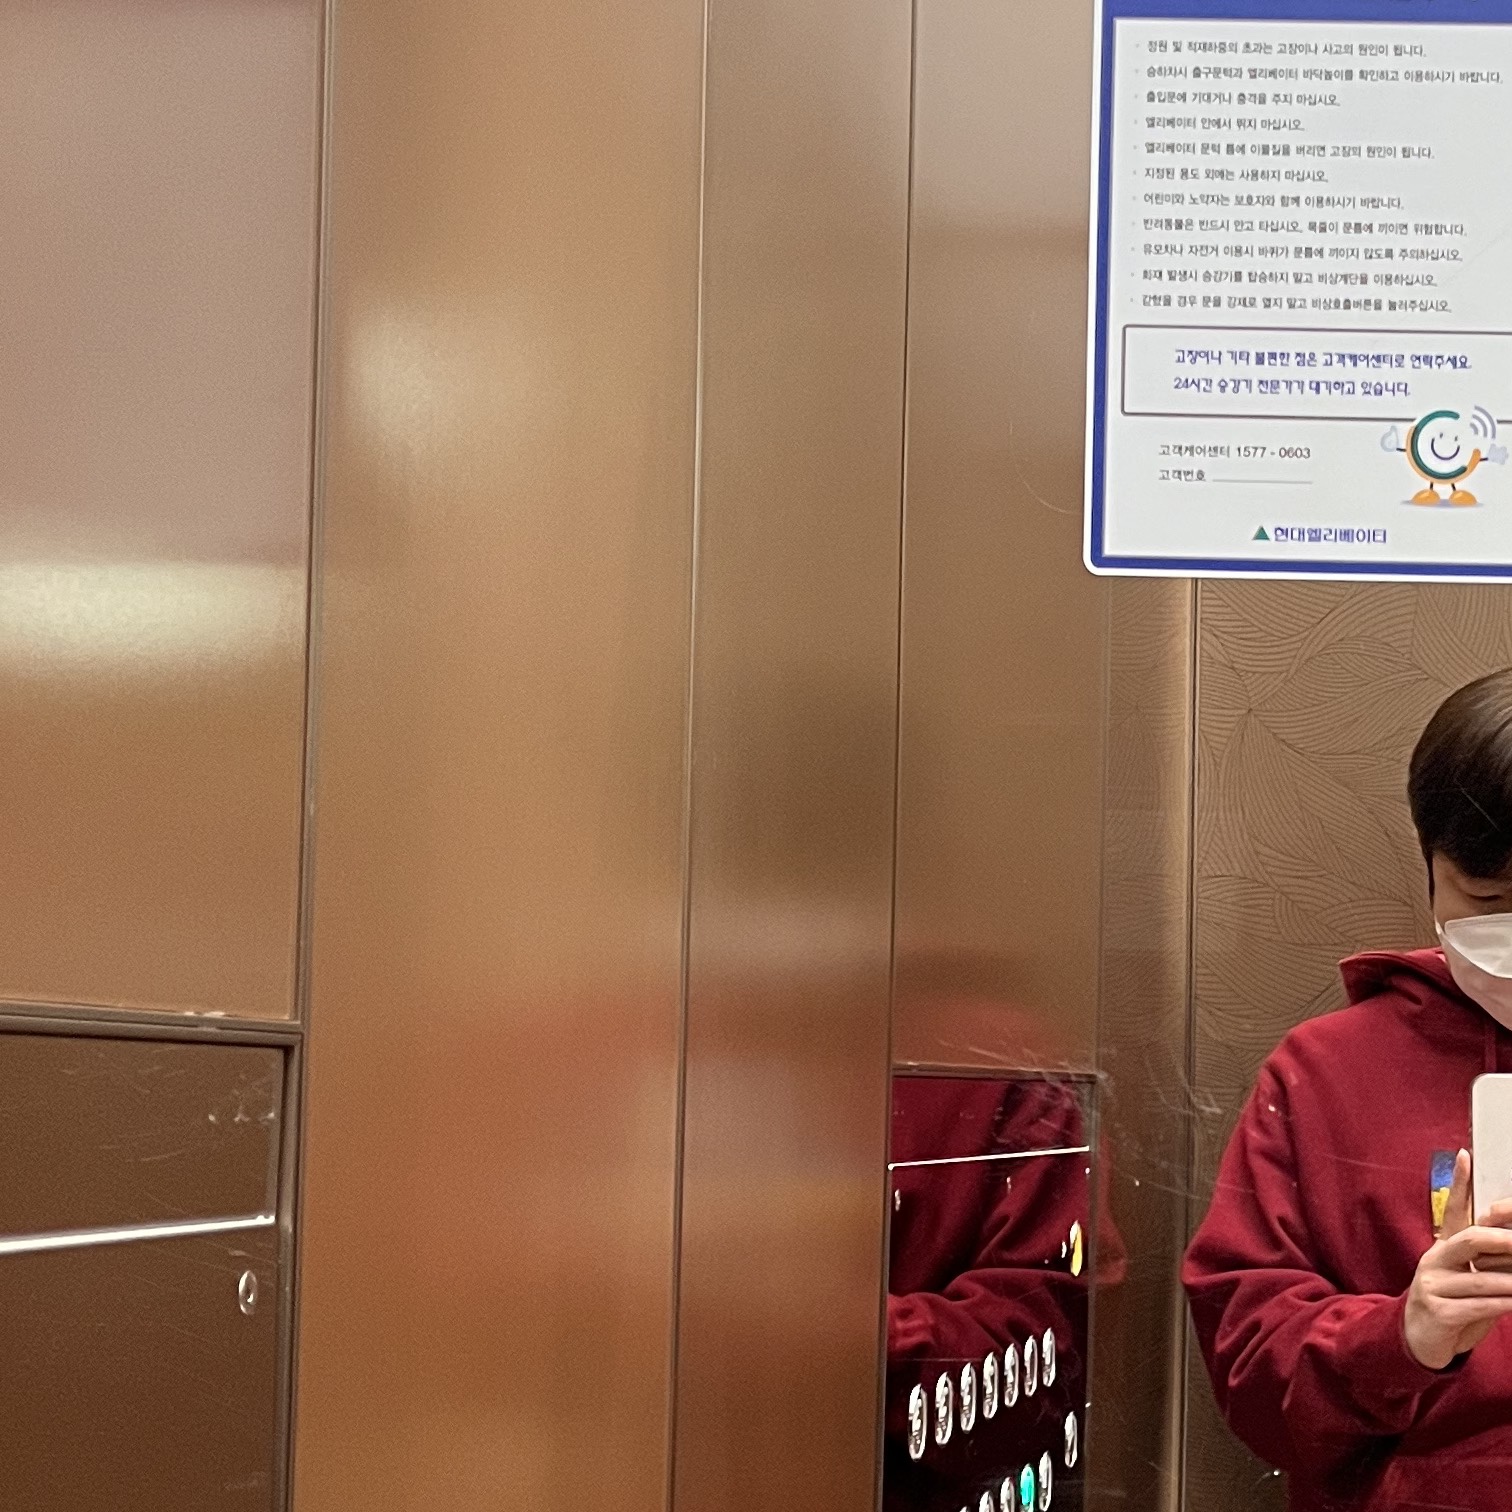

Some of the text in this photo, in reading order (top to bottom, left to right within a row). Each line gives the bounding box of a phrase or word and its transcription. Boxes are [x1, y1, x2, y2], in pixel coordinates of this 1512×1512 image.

[1147, 39, 1167, 52] 정원
[1172, 40, 1182, 52] 및
[1187, 41, 1238, 54] 적재하중의
[1276, 42, 1318, 55] 고장이나
[1321, 42, 1353, 55] 사고의
[1358, 43, 1388, 56] 원인이
[1393, 44, 1426, 57] 됩니다.
[1192, 65, 1243, 79] 출구문턱과
[1403, 69, 1454, 82] 이용하시기
[1459, 71, 1502, 83] 바랍니다.
[1146, 90, 1340, 106] 출입문에 기대거나 충격을 주지 마십시오.
[1200, 117, 1231, 130] 안에서
[1260, 118, 1305, 131] 마십시오.
[1200, 142, 1220, 155] 문턱
[1225, 143, 1245, 155] 틈에
[1295, 144, 1325, 157] 버리면
[1329, 145, 1361, 157] 고장의
[1366, 145, 1396, 158] 원인이
[1401, 146, 1434, 158] 됩니다.
[1144, 167, 1328, 182] 지정된 용도 외에는 사용하지 마십시오.
[1143, 192, 1403, 209] 어린이와 노약자는 보호자와 함께 이용하시기 바랍니다.
[1142, 217, 1194, 231] 반려동물은
[1198, 219, 1229, 232] 반드시
[1233, 219, 1254, 232] 안고
[1258, 219, 1303, 233] 타십시오.
[1342, 221, 1373, 234] 문틈에
[1377, 222, 1408, 235] 끼이면
[1413, 223, 1467, 235] 위험합니다.
[1143, 243, 1462, 261] 유모차나 자전거 이용시 바퀴가 문틈에 끼이지 않도록 주의하십시오.
[1142, 268, 1437, 286] 화재 발생시 승강기를 탑승하지 말고 비상계단을 이용하십시오.
[1177, 294, 1197, 307] 경우
[1201, 295, 1221, 308] 문을
[1226, 295, 1257, 308] 강제로
[1261, 296, 1282, 309] 열지
[1286, 297, 1307, 309] 말고
[1311, 297, 1382, 311] 비상호출버튼을
[1387, 299, 1451, 313] 눌러주십시오.
[1174, 348, 1472, 369] 고장이나 기타 불편한 점은 고객케어센터로 연락주세요.
[1173, 376, 1410, 397] 24시간 승강기 전문가가 대기하고 있습니다.
[1158, 444, 1230, 458] 고객케어센터
[1236, 445, 1266, 458] 1577
[1278, 446, 1310, 459] 0603
[1158, 469, 1206, 481] 고객번호
[1273, 527, 1388, 545] 현대엘리베이터
